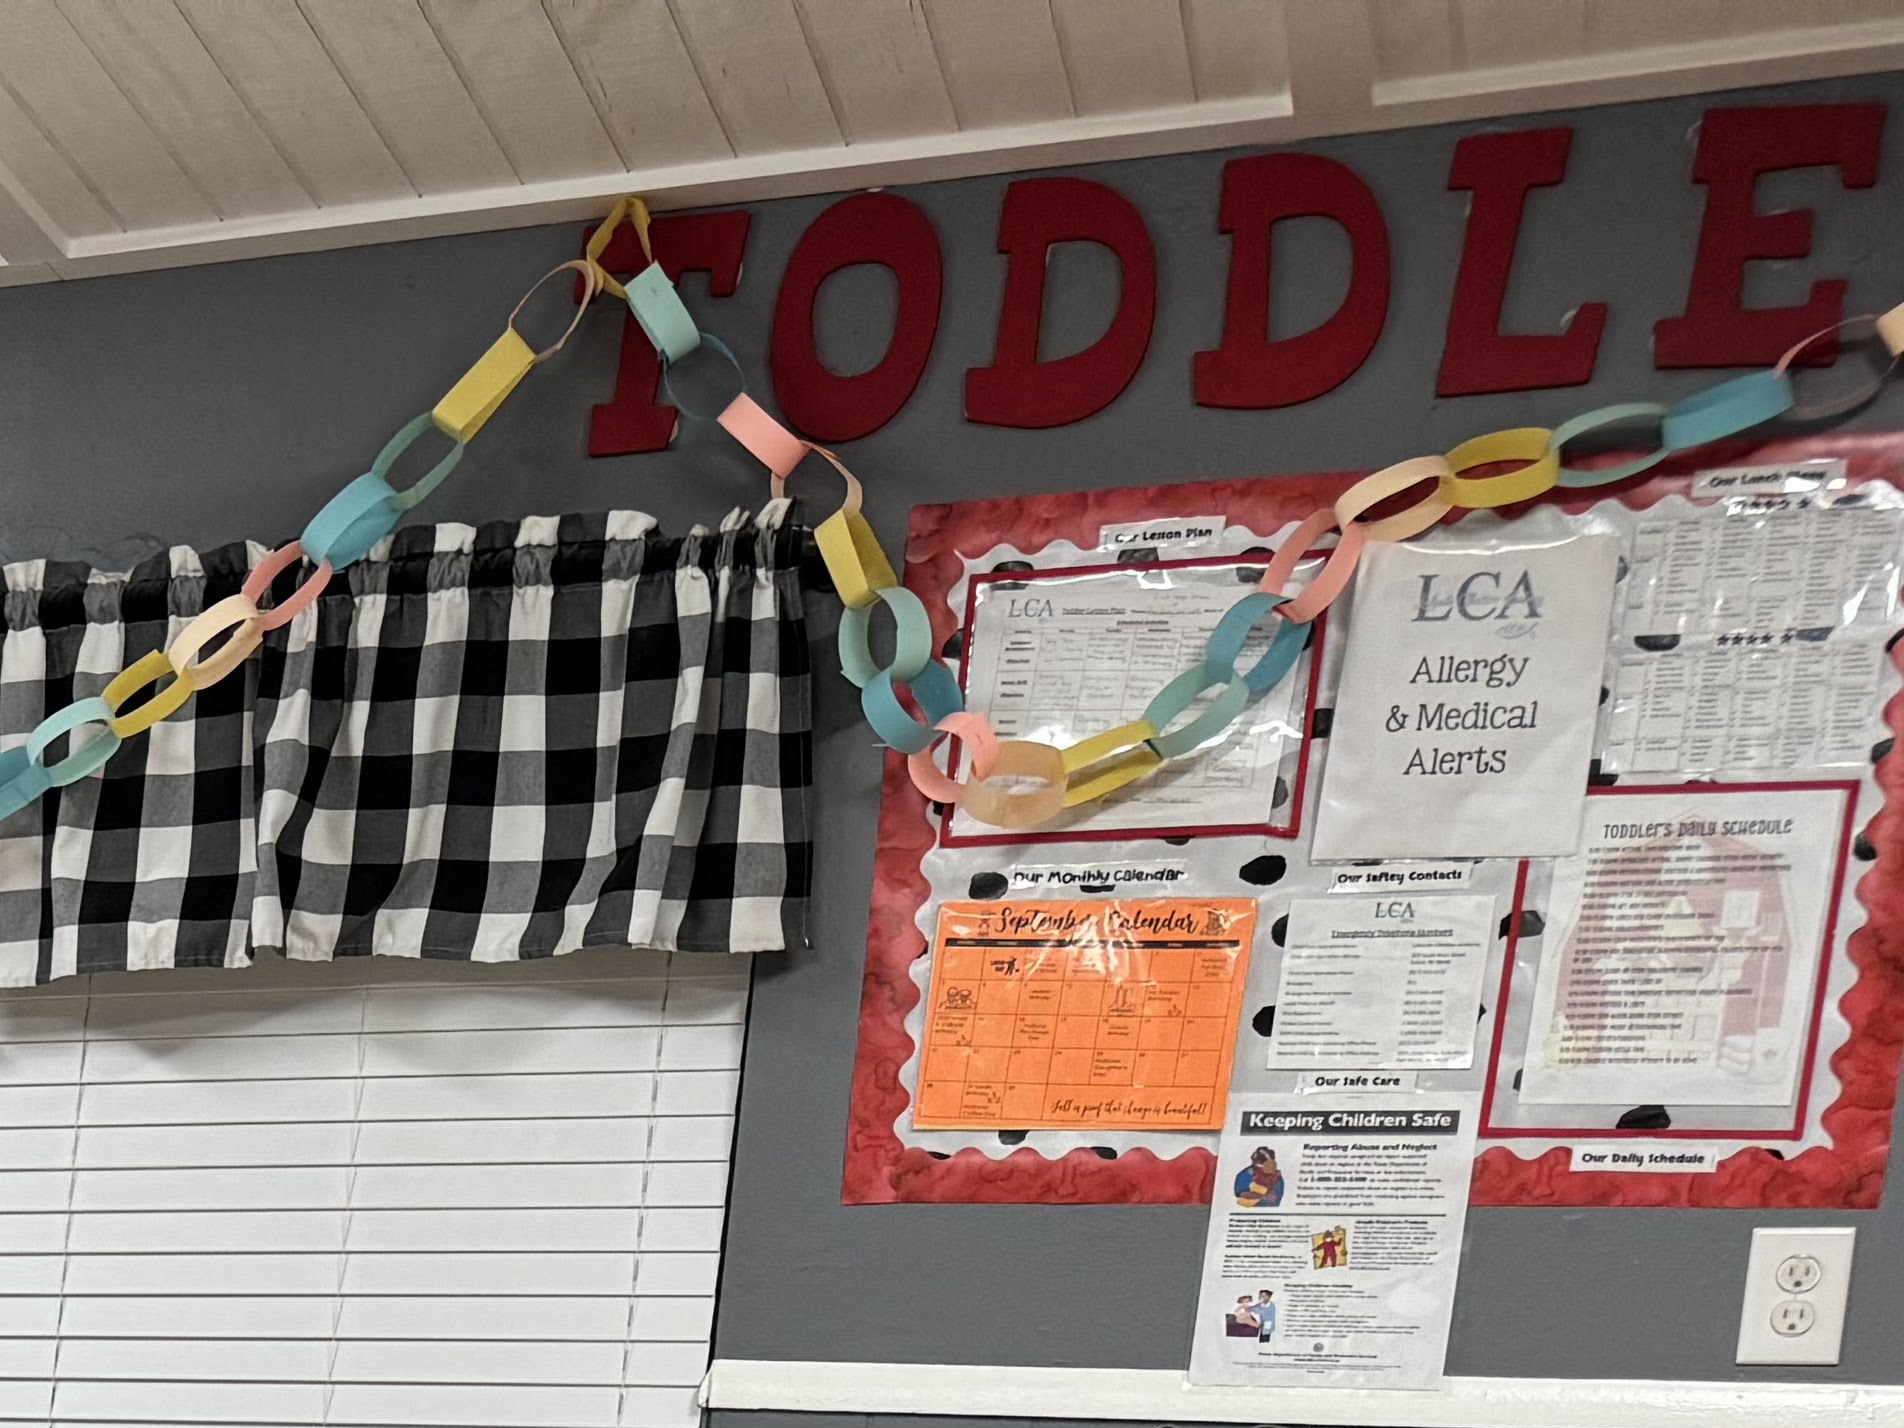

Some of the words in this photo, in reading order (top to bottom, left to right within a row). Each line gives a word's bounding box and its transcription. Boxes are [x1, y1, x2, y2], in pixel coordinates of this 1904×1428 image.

[575, 103, 1885, 456] TODDLE
[1142, 529, 1182, 541] Lesson
[1186, 527, 1213, 538] Plan
[1412, 570, 1543, 622] LCA
[1008, 598, 1054, 618] LCA
[1409, 654, 1530, 688] Allergy
[1385, 705, 1409, 732] &
[1415, 701, 1539, 731] Medical
[1402, 746, 1507, 775] Alerts
[1337, 873, 1361, 883] Our
[1408, 870, 1463, 882] Contacts
[1374, 901, 1415, 919] LCA
[1315, 1077, 1339, 1087] Our
[1343, 1076, 1369, 1087] Safe
[1372, 1076, 1401, 1087] Care
[1250, 1113, 1324, 1131] Keeping
[1328, 1112, 1407, 1127] Children
[1411, 1112, 1452, 1127] Safe
[1581, 1152, 1606, 1163] Our
[1611, 1152, 1644, 1167] Daily
[1648, 1152, 1705, 1164] Schedule
